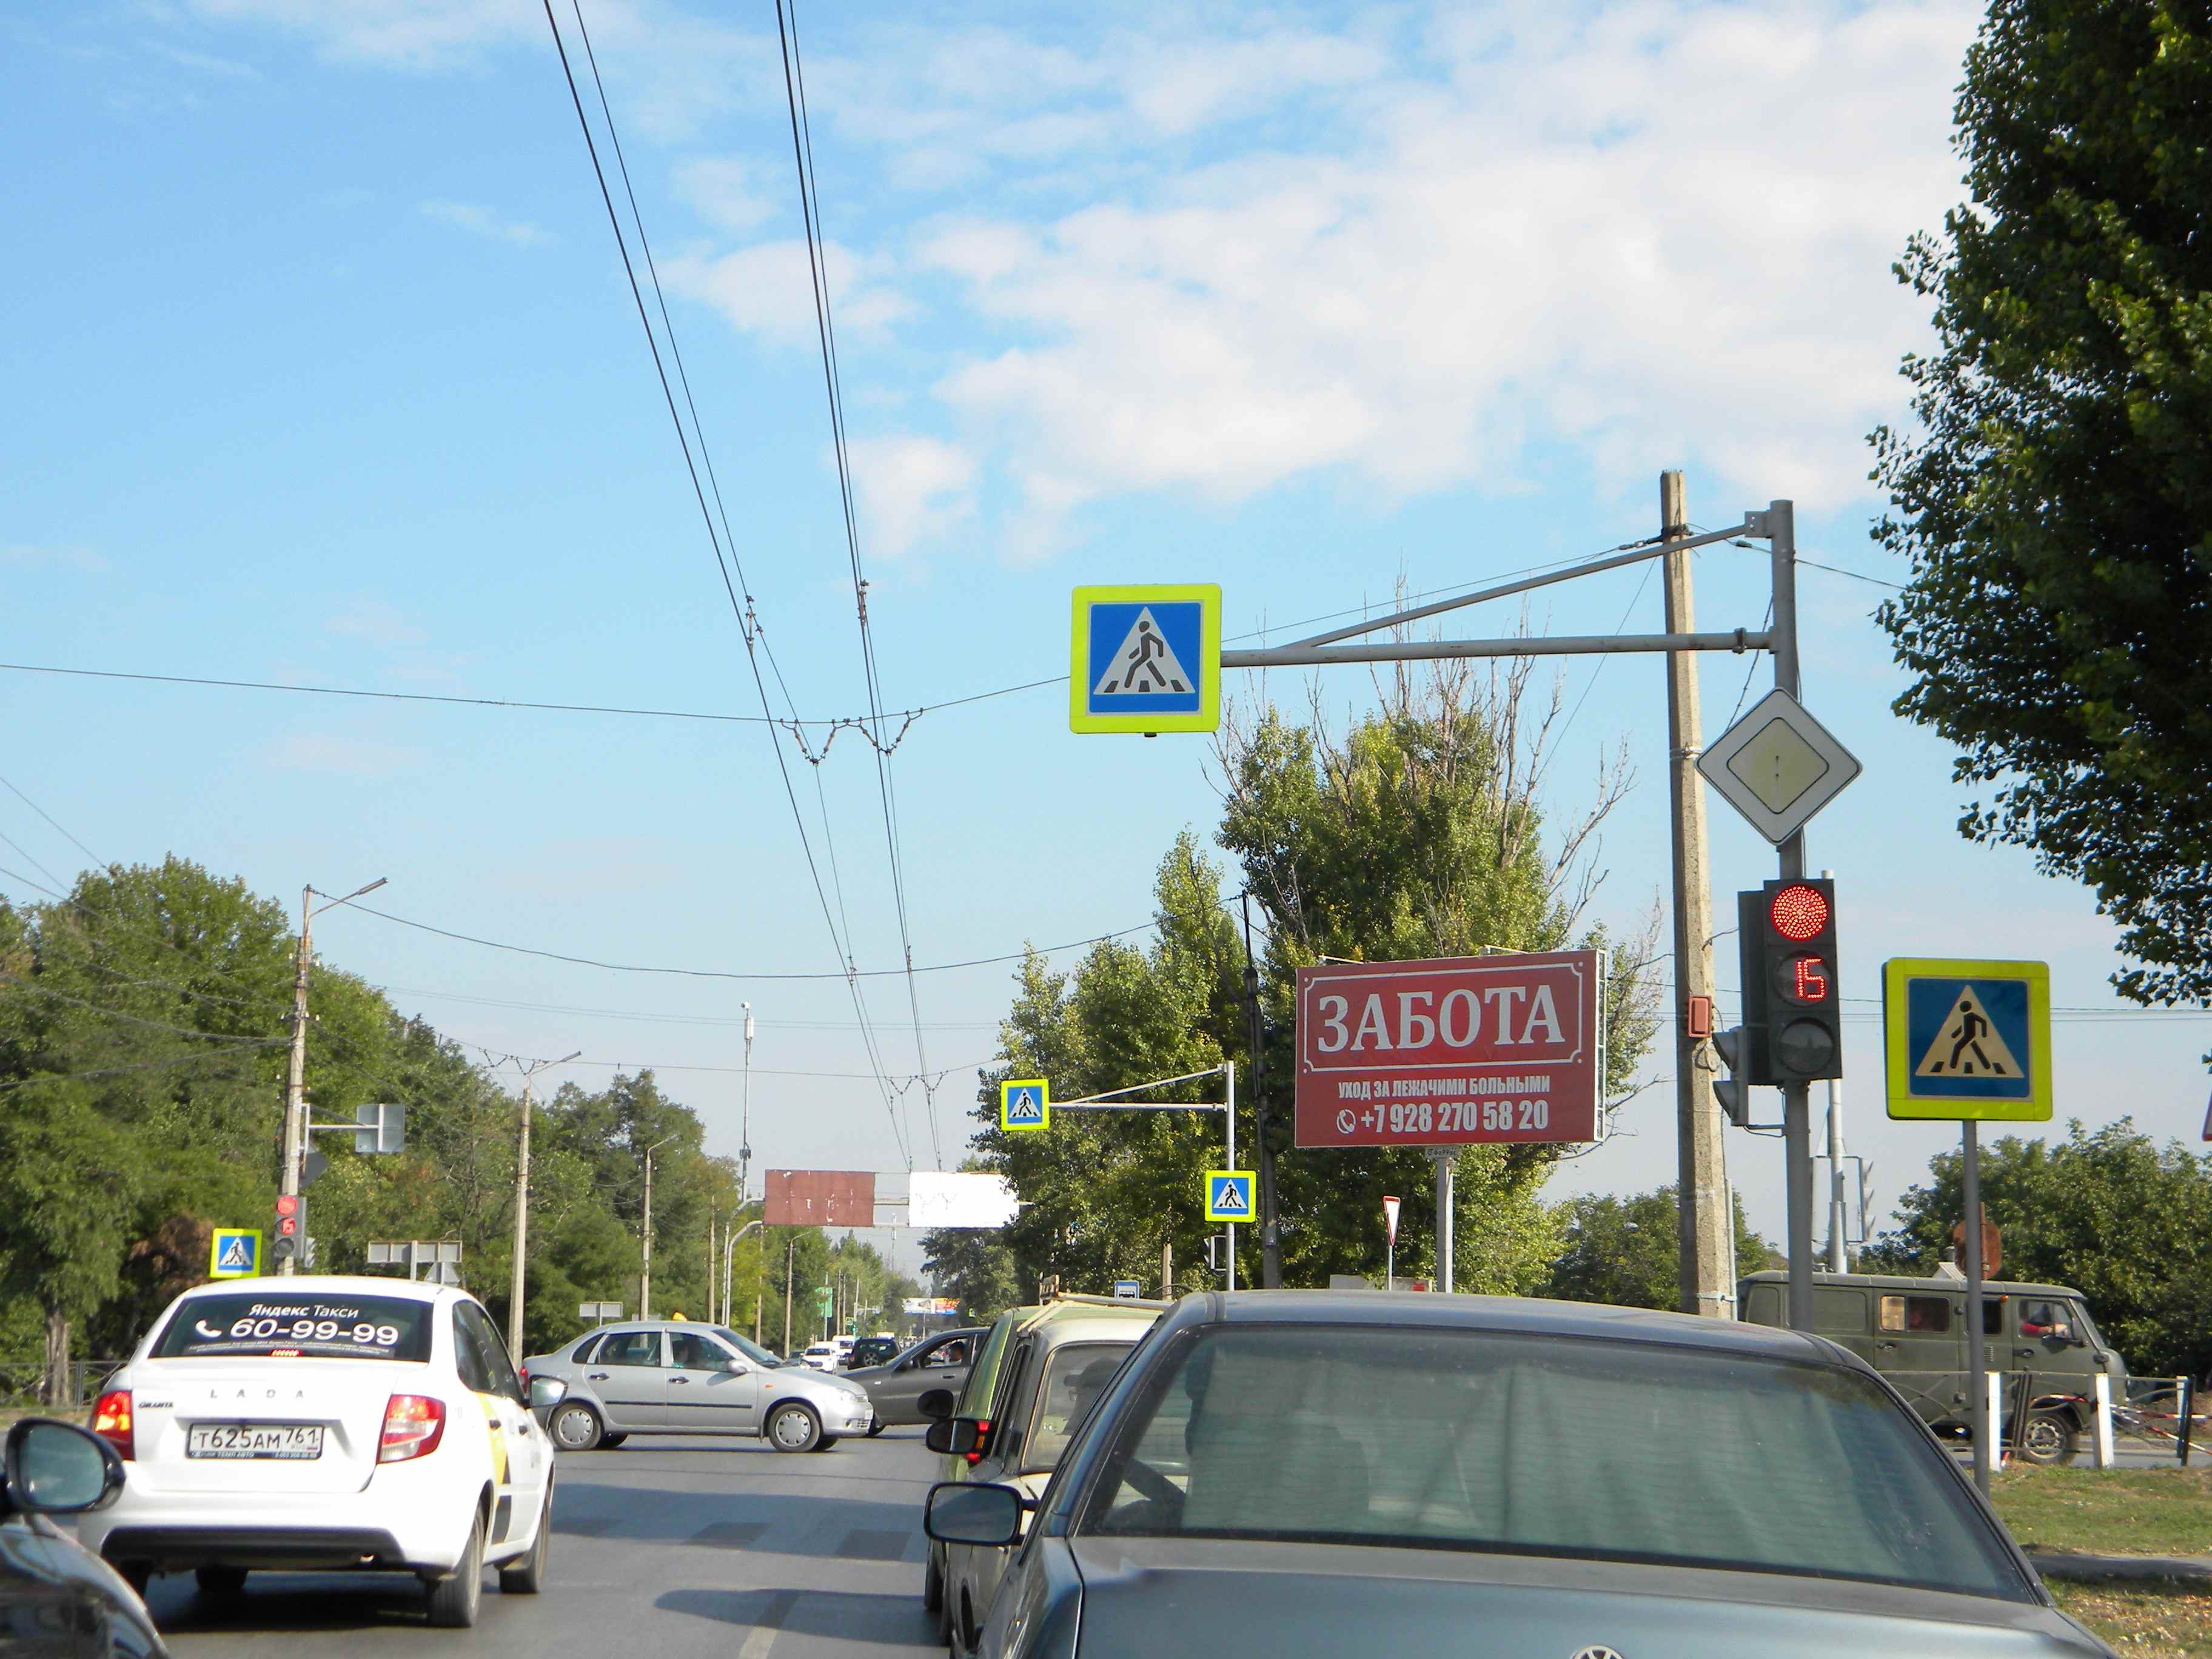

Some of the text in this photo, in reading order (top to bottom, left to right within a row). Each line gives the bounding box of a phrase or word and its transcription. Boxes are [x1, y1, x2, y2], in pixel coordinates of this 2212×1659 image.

[1796, 957, 1826, 999] 15
[1318, 984, 1566, 1052] ЗАБОТА
[1338, 1076, 1550, 1100] УХОД ЗА ЛЕЖАЧИМИ БОЛЬНЫМИ
[1361, 1099, 1549, 1133] +7 928 270 58 20
[249, 1304, 359, 1319] Яндекс Такси
[230, 1318, 398, 1346] 60-99-99
[210, 1389, 304, 1399] LADA
[285, 1427, 317, 1444] 761
